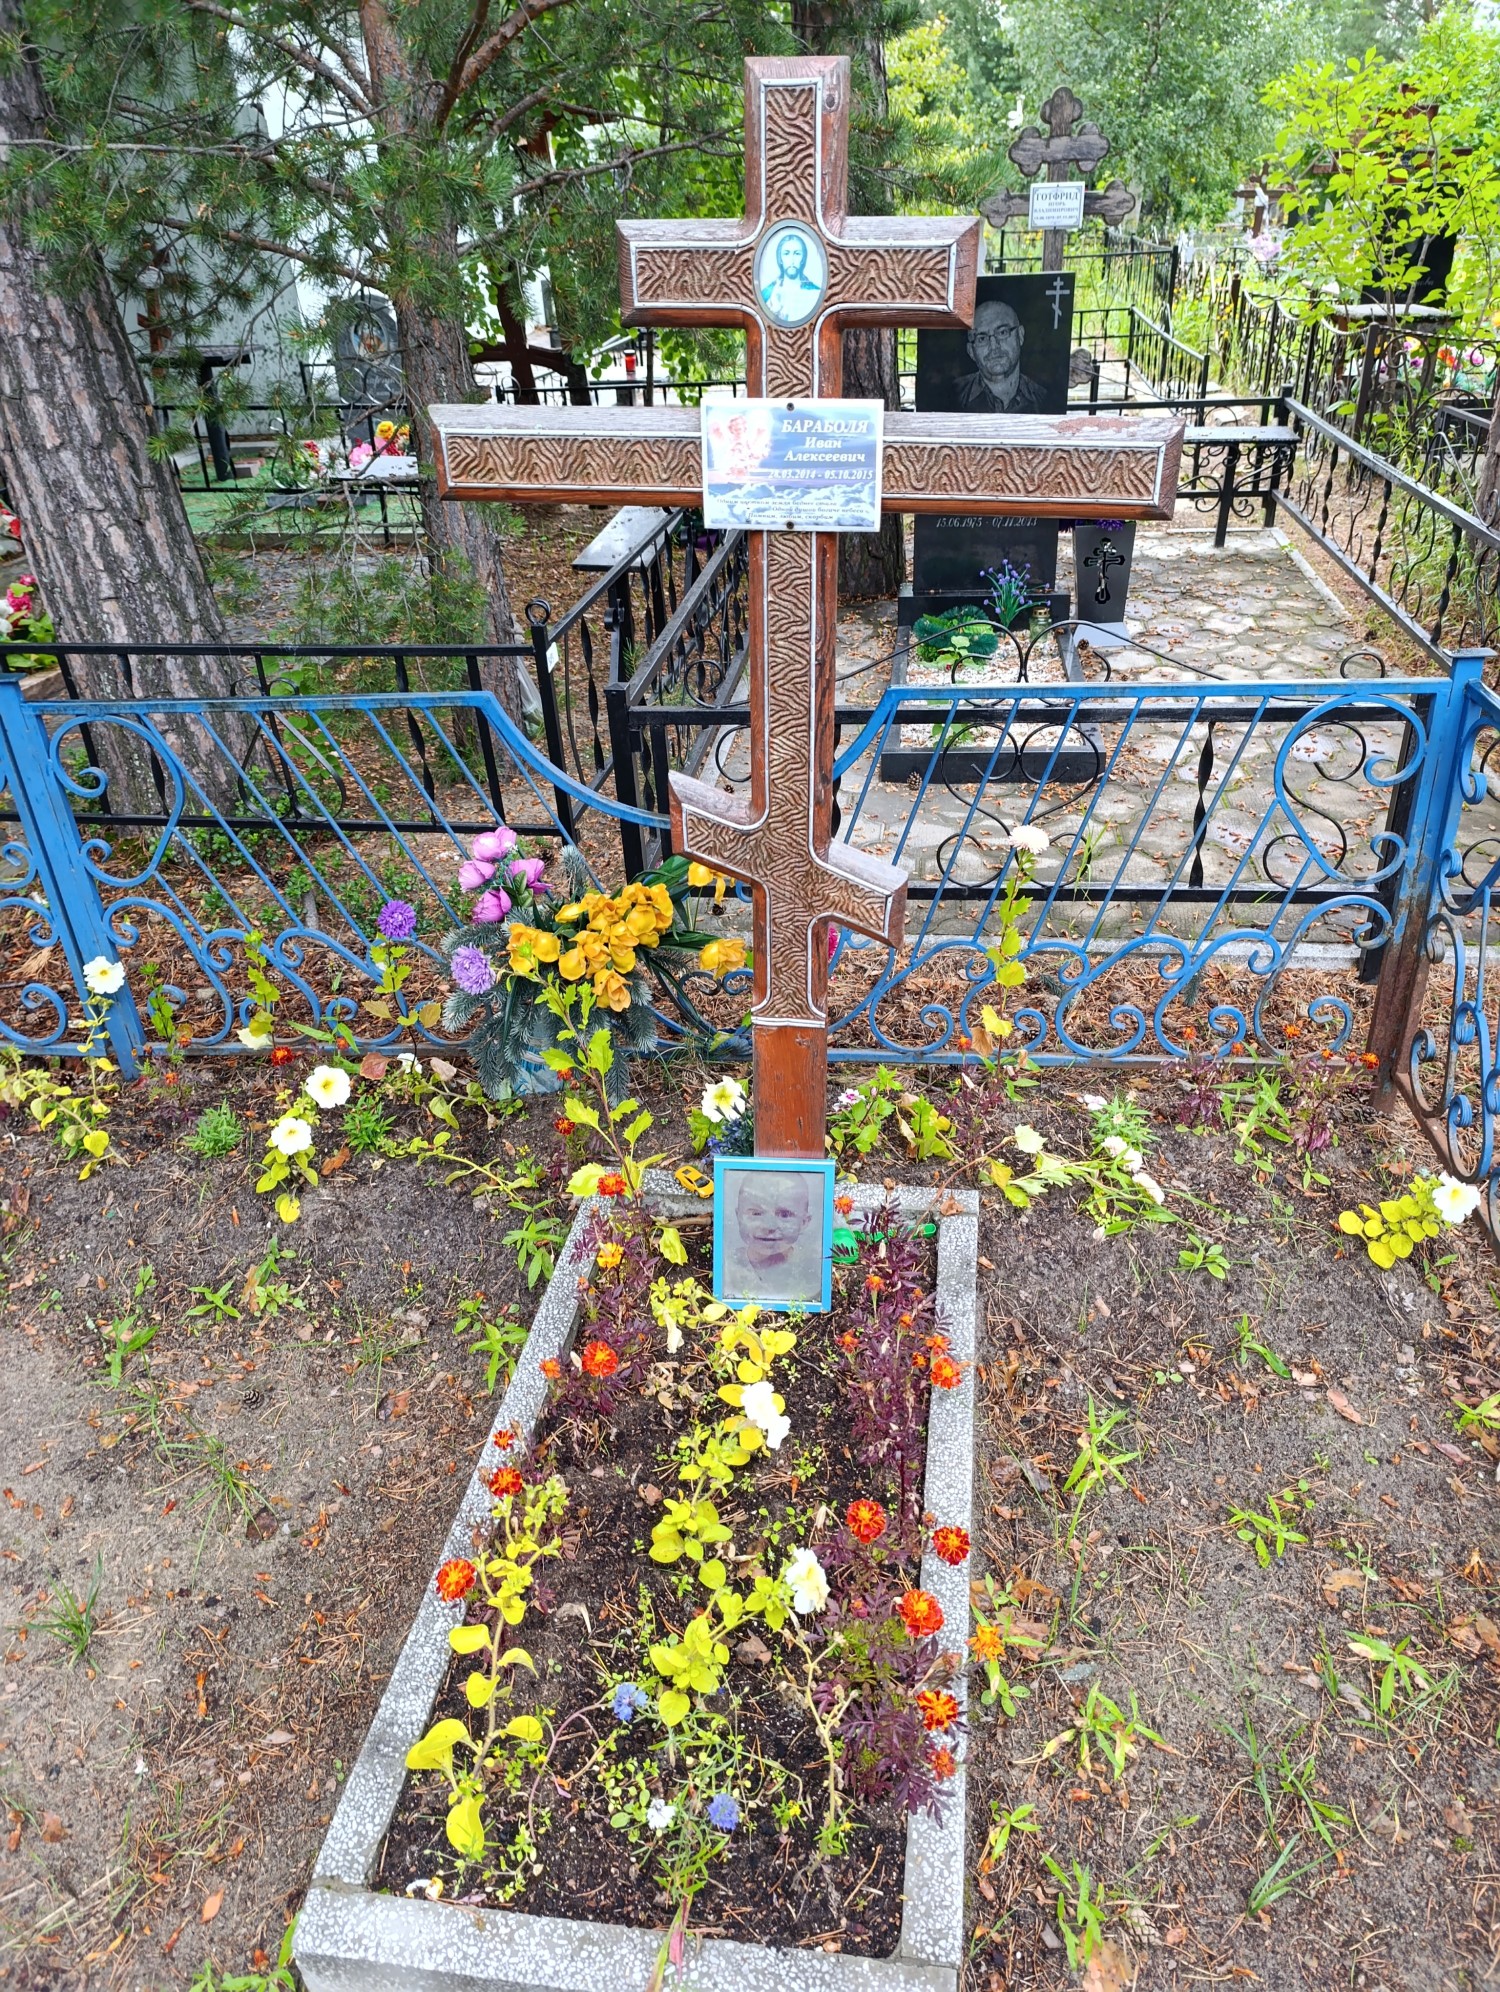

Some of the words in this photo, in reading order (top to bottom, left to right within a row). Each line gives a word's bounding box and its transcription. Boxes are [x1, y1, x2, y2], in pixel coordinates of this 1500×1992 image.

[1036, 192, 1079, 201] ГОТФРИД
[781, 419, 869, 433] БАРАБОЛЯ
[805, 436, 842, 448] Иван
[784, 450, 866, 462] Алексеевич
[768, 469, 816, 479] 28.03.2014
[824, 469, 873, 480] 05.10.2015
[936, 517, 982, 528] 15.06.1975
[992, 516, 1037, 528] 07.11.2013
